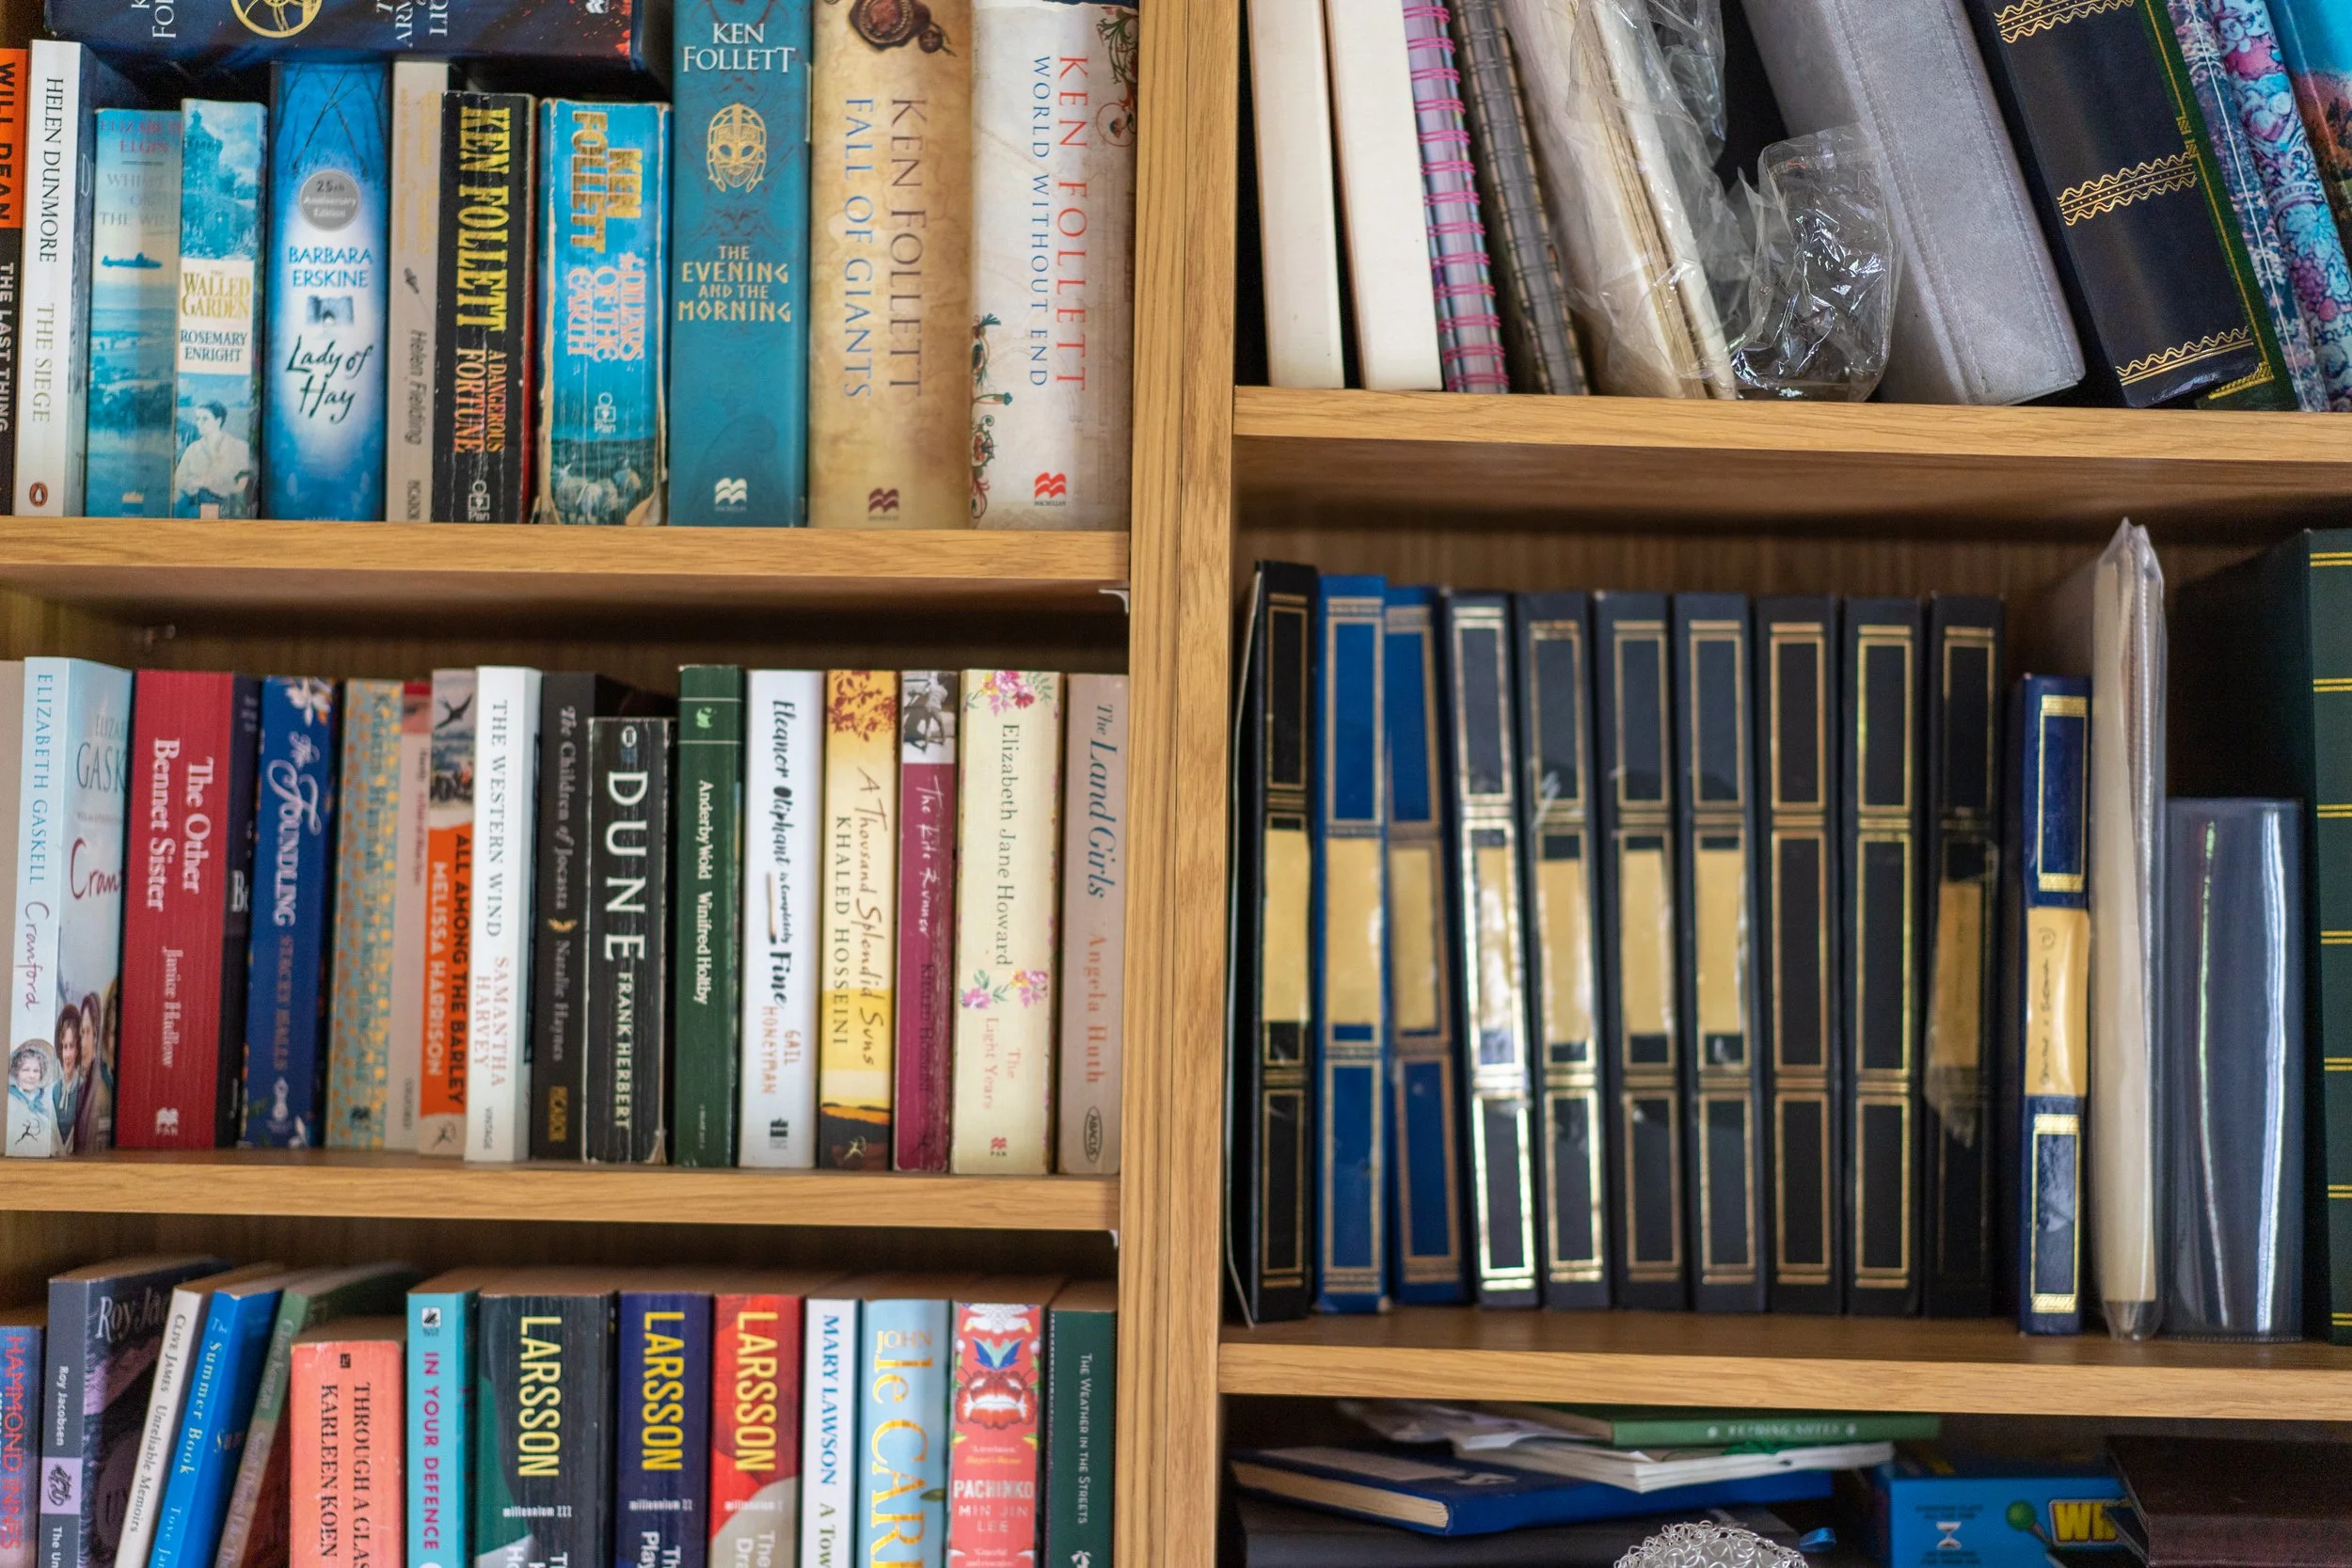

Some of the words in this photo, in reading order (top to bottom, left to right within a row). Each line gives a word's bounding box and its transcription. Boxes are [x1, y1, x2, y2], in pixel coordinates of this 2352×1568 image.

[682, 46, 796, 73] FOLLETT
[711, 23, 765, 45] KEN
[0, 61, 16, 123] WILL
[45, 78, 64, 144] HELEN
[1032, 56, 1051, 158] WORLD
[1058, 56, 1089, 149] KEN
[459, 105, 511, 174] KEN
[846, 99, 874, 181] FALL
[891, 99, 927, 186] KEN
[0, 142, 13, 221] DEAN
[40, 151, 61, 263] DUNMORE
[570, 110, 608, 254] FOLLETT
[607, 148, 643, 219] KEN
[844, 196, 874, 245] OF
[1030, 174, 1050, 312] WITHOUT
[0, 262, 14, 302] THE
[183, 271, 251, 298] WALLED
[288, 245, 373, 264] BARBARA
[292, 270, 370, 288] ERSKINE
[456, 184, 510, 332] FOLLETT
[681, 261, 789, 284] EVENING
[718, 245, 750, 261] THE
[182, 294, 250, 320] GARDEN
[567, 266, 594, 357] EARTH
[677, 300, 792, 323] MORNING
[697, 284, 733, 300] AND
[738, 284, 770, 300] THE
[889, 210, 927, 398] FOLLETT
[1056, 181, 1088, 391] FOLLETT
[0, 309, 12, 363] LAST
[35, 303, 55, 350] THE
[181, 329, 248, 347] ROSEMARY
[184, 346, 242, 363] ENRIGHT
[410, 329, 427, 377] Helen
[489, 349, 507, 361] A
[845, 259, 873, 397] GIANTS
[1029, 329, 1048, 387] END
[32, 357, 53, 423] SIEGE
[285, 334, 342, 383] Lady
[345, 343, 373, 380] of
[0, 367, 11, 434] THING
[299, 374, 357, 425] Hay
[405, 380, 427, 446] Fielding
[454, 347, 486, 453] FORTUNE
[486, 363, 507, 452] DANGEROUS
[29, 673, 53, 790] ELIZABETH
[491, 699, 508, 747] THE
[561, 705, 577, 737] The
[772, 700, 797, 779] Eleanor
[1096, 704, 1113, 736] The
[151, 737, 181, 832] Bennet
[185, 755, 214, 808] The
[558, 740, 577, 822] Children
[856, 767, 881, 792] A
[915, 774, 945, 814] The
[1000, 723, 1020, 821] Elizabeth
[1089, 738, 1118, 822] Land
[489, 754, 506, 864] WESTERN
[554, 824, 575, 847] of
[694, 779, 714, 846] Anderby
[769, 785, 795, 866] Oliphant
[28, 799, 49, 884] GASKELL
[183, 812, 212, 895] Other
[453, 832, 471, 875] ALL
[604, 770, 649, 960] DUNE
[696, 845, 714, 880] Wold
[835, 815, 851, 916] KHALED
[854, 798, 888, 895] Thousand
[915, 824, 940, 860] Kite
[998, 828, 1017, 879] Jane
[1088, 826, 1117, 898] Girls
[146, 837, 177, 912] Sister
[486, 871, 503, 938] WIND
[554, 846, 573, 911] Jocasta
[779, 871, 790, 882] is
[918, 867, 941, 938] Runner
[430, 860, 449, 956] MELISSA
[452, 879, 469, 965] AMONG
[695, 891, 713, 955] Winifred
[995, 885, 1014, 965] Howard
[14, 900, 50, 1011] Cranford
[850, 897, 886, 1000] Splendid
[1083, 935, 1107, 1013] Angela
[451, 972, 468, 1014] THE
[615, 971, 634, 1037] FRANK
[693, 958, 712, 1005] Holtby
[770, 952, 792, 1010] Fine
[833, 927, 850, 1045] HOSSEINI
[427, 959, 447, 1076] HARRISON
[474, 974, 492, 1069] HARVEY
[491, 956, 510, 1087] SAMANTHA
[784, 1030, 802, 1067] GAIL
[860, 1006, 884, 1066] Suns
[982, 1017, 999, 1058] Light
[448, 1019, 468, 1106] BARLEY
[761, 1005, 779, 1095] HONEYMAN
[1007, 1047, 1021, 1079] The
[1086, 1025, 1107, 1084] Huth
[613, 1040, 633, 1130] HERBERT
[982, 1064, 997, 1109] Years
[1088, 1115, 1098, 1157] ABACUS
[168, 1313, 187, 1351] CLIVE
[822, 1314, 840, 1382] MARY
[876, 1328, 933, 1354] JOHN
[56, 1365, 70, 1389] Roy
[160, 1354, 179, 1392] JAMES
[193, 1339, 224, 1420] Summer
[423, 1352, 439, 1376] IN
[642, 1312, 685, 1471] LARSSON
[735, 1312, 779, 1471] LARSSON
[872, 1354, 933, 1404] le
[1079, 1353, 1093, 1375] THE
[3, 1336, 27, 1472] HAMMOND
[56, 1390, 70, 1447] Jacobsen
[423, 1386, 439, 1447] YOUR
[517, 1316, 563, 1477] LARSSON
[1079, 1377, 1092, 1433] WEATHER
[142, 1404, 168, 1468] Unreliable
[179, 1427, 204, 1476] Book
[321, 1384, 339, 1489] KARLEEN
[353, 1381, 371, 1492] THROUGH
[820, 1386, 839, 1486] LAWSON
[1079, 1436, 1089, 1449] IN
[1079, 1451, 1089, 1473] THE
[1, 1478, 24, 1549] INNES
[130, 1474, 153, 1533] Memoirs
[353, 1496, 371, 1512] A
[422, 1457, 439, 1550] DEFENCE
[502, 1505, 555, 1518] millennium
[557, 1505, 573, 1517] III
[628, 1499, 681, 1512] millennium
[818, 1502, 836, 1517] A
[953, 1480, 1034, 1498] PACHINKO
[958, 1504, 992, 1516] MIN
[1001, 1505, 1029, 1517] JIN
[1077, 1476, 1091, 1525] STREETS
[51, 1526, 63, 1549] The
[320, 1495, 338, 1558] KOEN
[977, 1520, 1009, 1532] LEE
